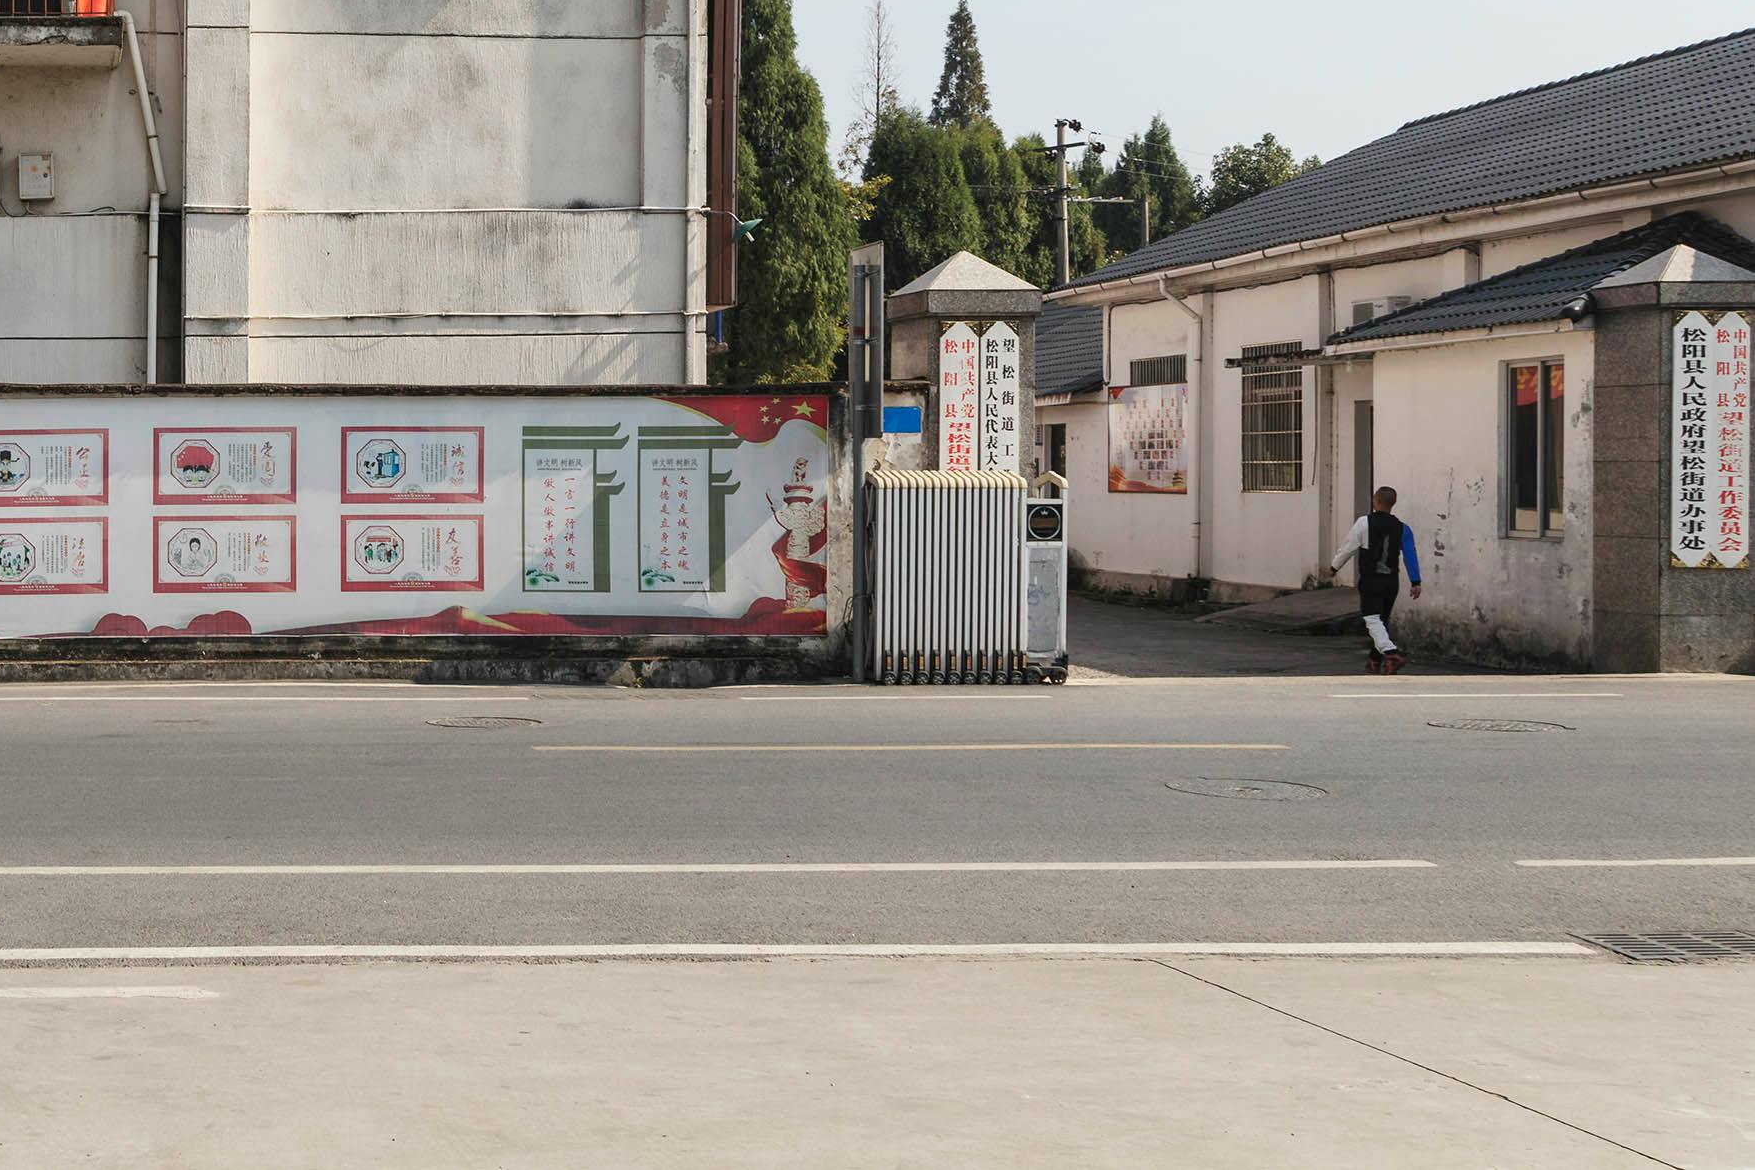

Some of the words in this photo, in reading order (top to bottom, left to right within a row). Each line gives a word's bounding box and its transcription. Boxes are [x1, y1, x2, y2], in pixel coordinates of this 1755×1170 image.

[985, 338, 999, 472] 松阳县人民代表大
[1001, 338, 1015, 472] 望松街道工
[1733, 328, 1747, 408] 中国共产党
[76, 447, 90, 478] 公正
[1679, 327, 1707, 551] 松阳县人民政府望松街道办事处
[543, 478, 556, 572] 做人做事讲诚信
[564, 477, 576, 572] 一言一行讲文明
[659, 476, 672, 571] 美德是立身之本
